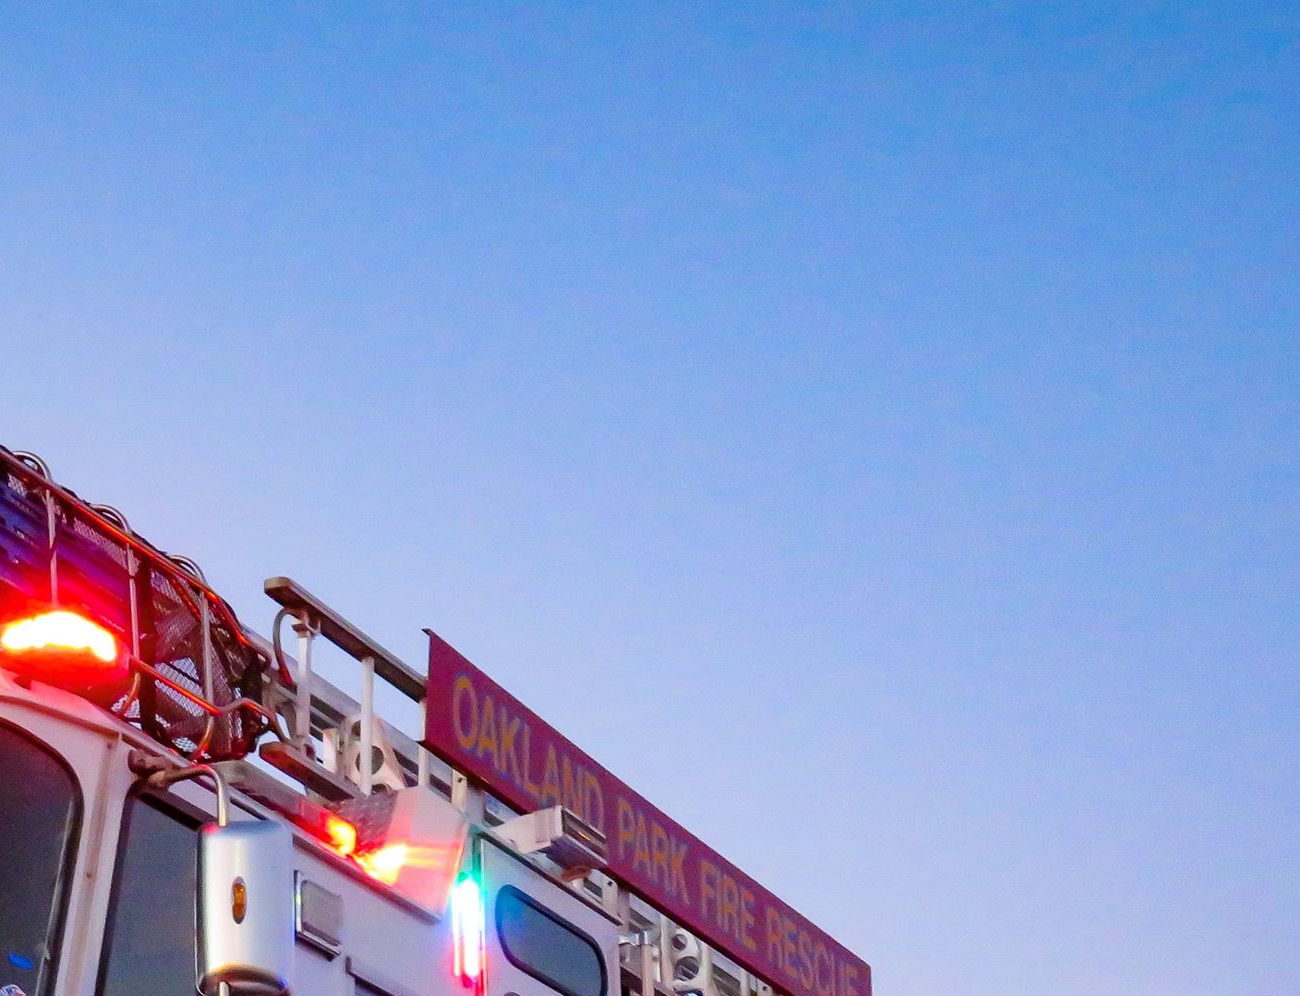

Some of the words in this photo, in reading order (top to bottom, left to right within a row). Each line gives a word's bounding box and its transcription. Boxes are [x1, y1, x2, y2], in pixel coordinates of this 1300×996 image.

[452, 673, 605, 837] OAKLAND
[615, 797, 690, 905] PARK
[700, 858, 757, 952] FIRE
